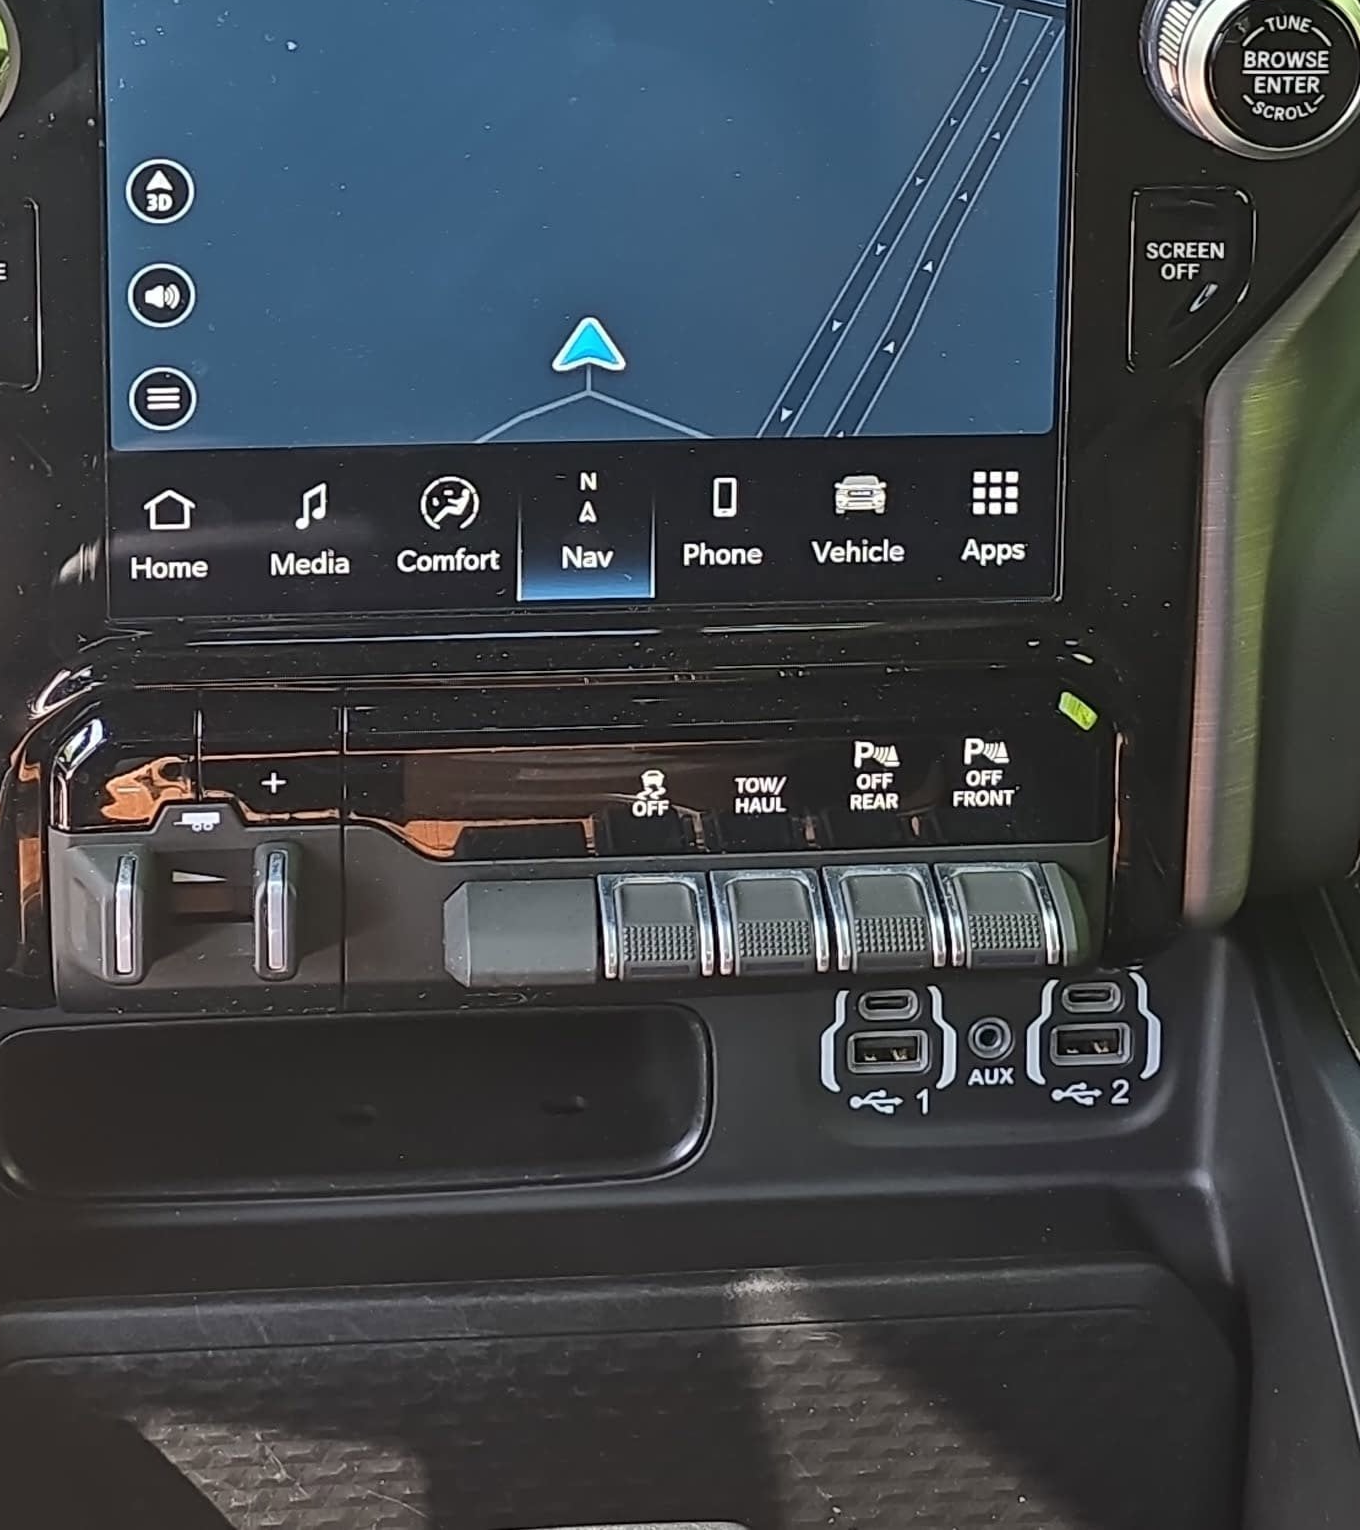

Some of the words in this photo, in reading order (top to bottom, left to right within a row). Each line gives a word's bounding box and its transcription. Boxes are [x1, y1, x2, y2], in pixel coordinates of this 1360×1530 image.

[1264, 15, 1313, 35] TUNE
[1244, 50, 1329, 69] BROWSE
[1254, 76, 1319, 95] ENTER
[1252, 100, 1317, 121] SCROLL
[146, 194, 172, 212] 3D
[1146, 242, 1225, 260] SCREEN
[1161, 263, 1200, 280] OFF
[579, 473, 598, 491] N
[396, 547, 500, 575] Comfort
[561, 546, 613, 570] Nav
[683, 542, 763, 568] Phone
[811, 539, 905, 565] Vehicle
[961, 538, 1026, 567] Apps
[129, 556, 208, 580] Home
[269, 550, 351, 577] Media
[735, 776, 786, 795] TOW/
[856, 772, 893, 791] OFF
[966, 770, 1002, 788] OFF
[632, 799, 669, 817] OFF
[735, 794, 786, 814] HAUL
[850, 792, 898, 810] REAR
[953, 789, 1015, 808] FRONT
[968, 1066, 1015, 1086] AUX
[915, 1089, 931, 1114] 1
[1110, 1080, 1129, 1103] 2
